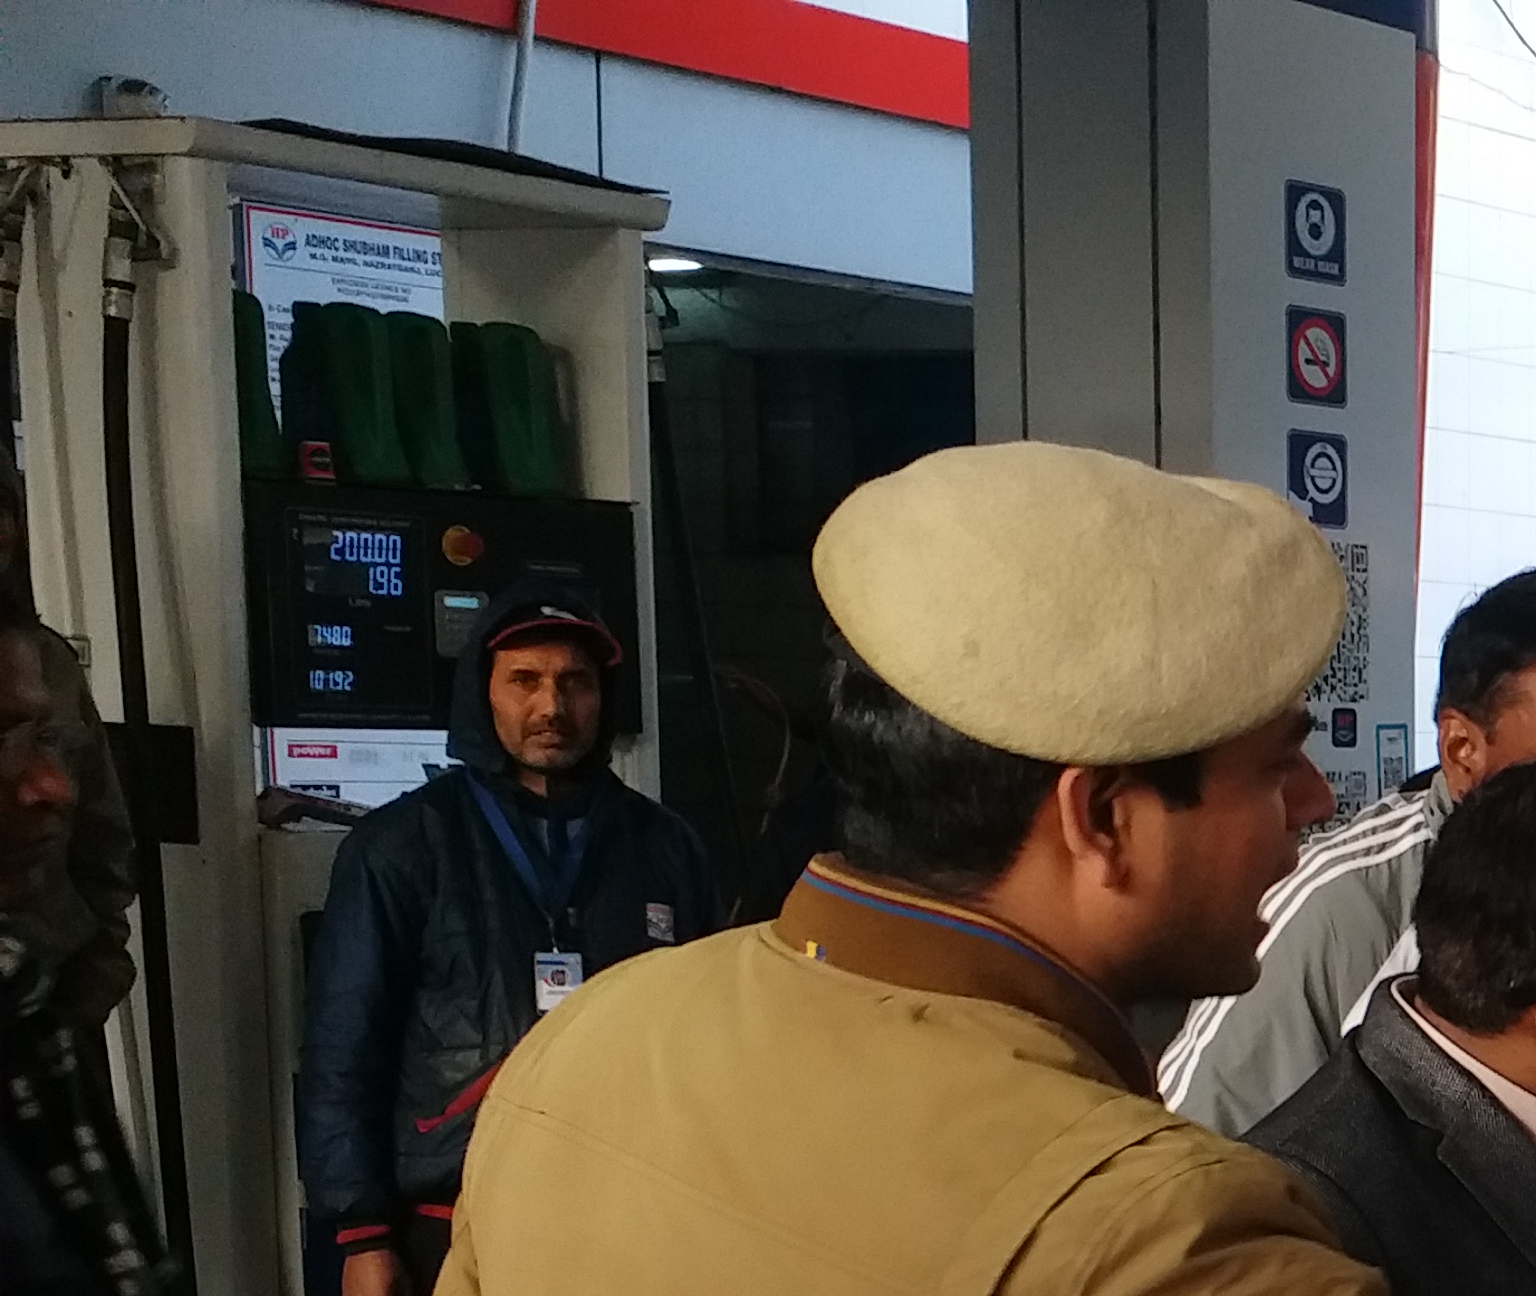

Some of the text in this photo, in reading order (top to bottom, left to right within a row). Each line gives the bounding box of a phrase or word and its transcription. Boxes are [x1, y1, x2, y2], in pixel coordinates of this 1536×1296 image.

[304, 233, 340, 251] ADHOC
[342, 239, 391, 260] SHUBHAM
[392, 246, 430, 264] FILLING
